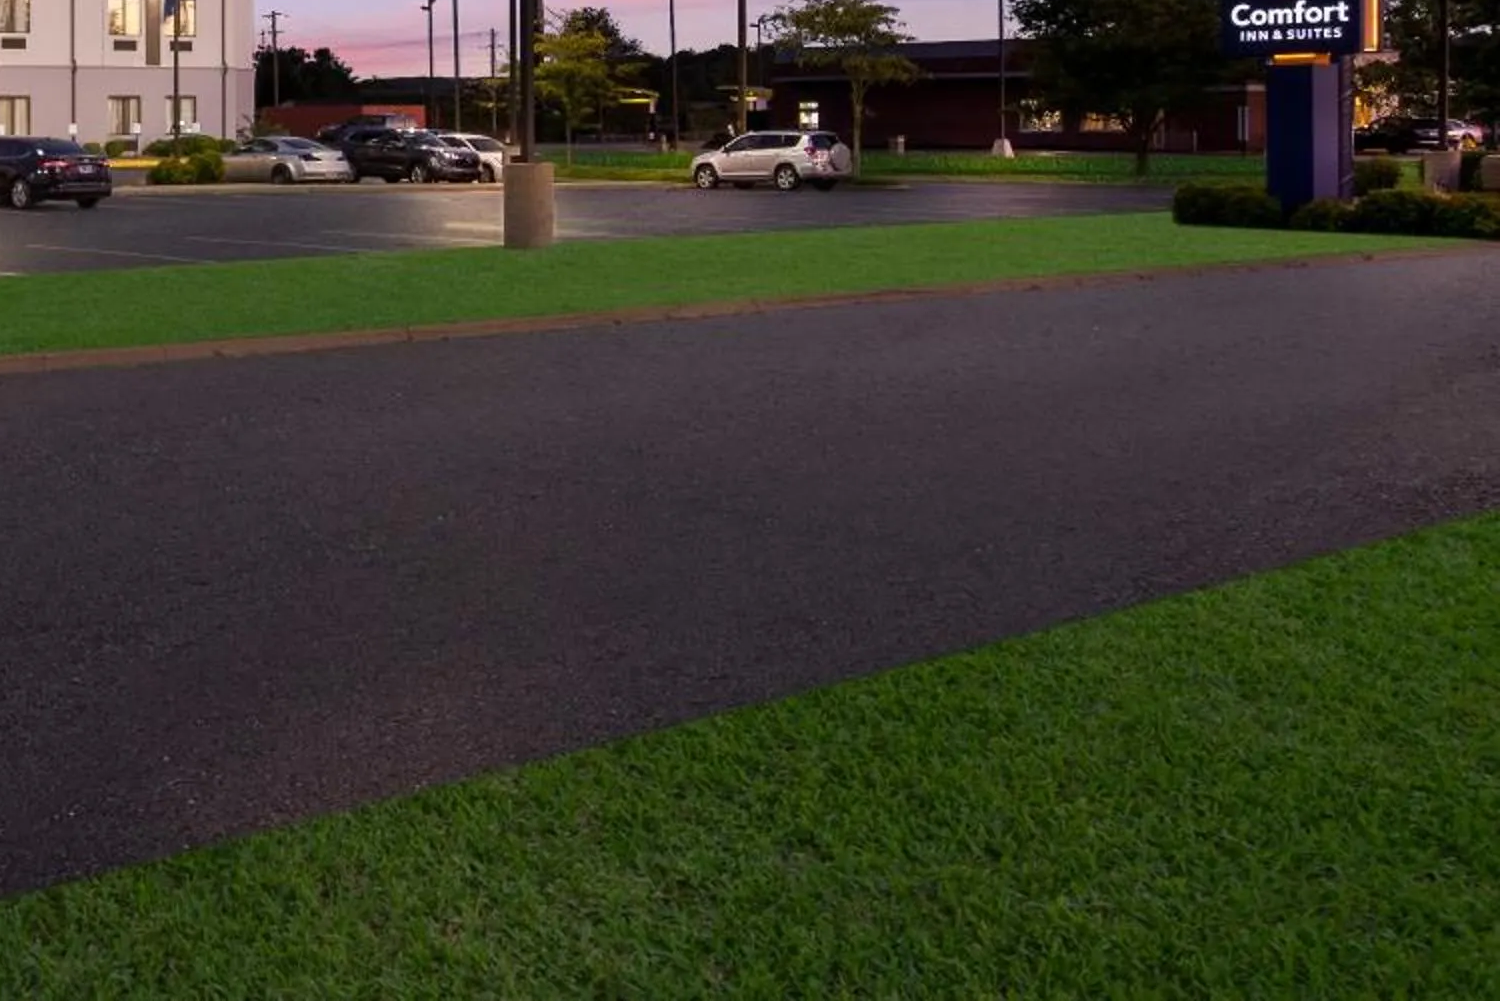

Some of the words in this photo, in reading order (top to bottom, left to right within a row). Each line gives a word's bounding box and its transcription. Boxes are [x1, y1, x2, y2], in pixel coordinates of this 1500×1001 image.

[1231, 0, 1349, 27] Comfort
[1240, 30, 1269, 42] INN
[1272, 30, 1283, 40] &
[1286, 26, 1343, 40] SUITES
